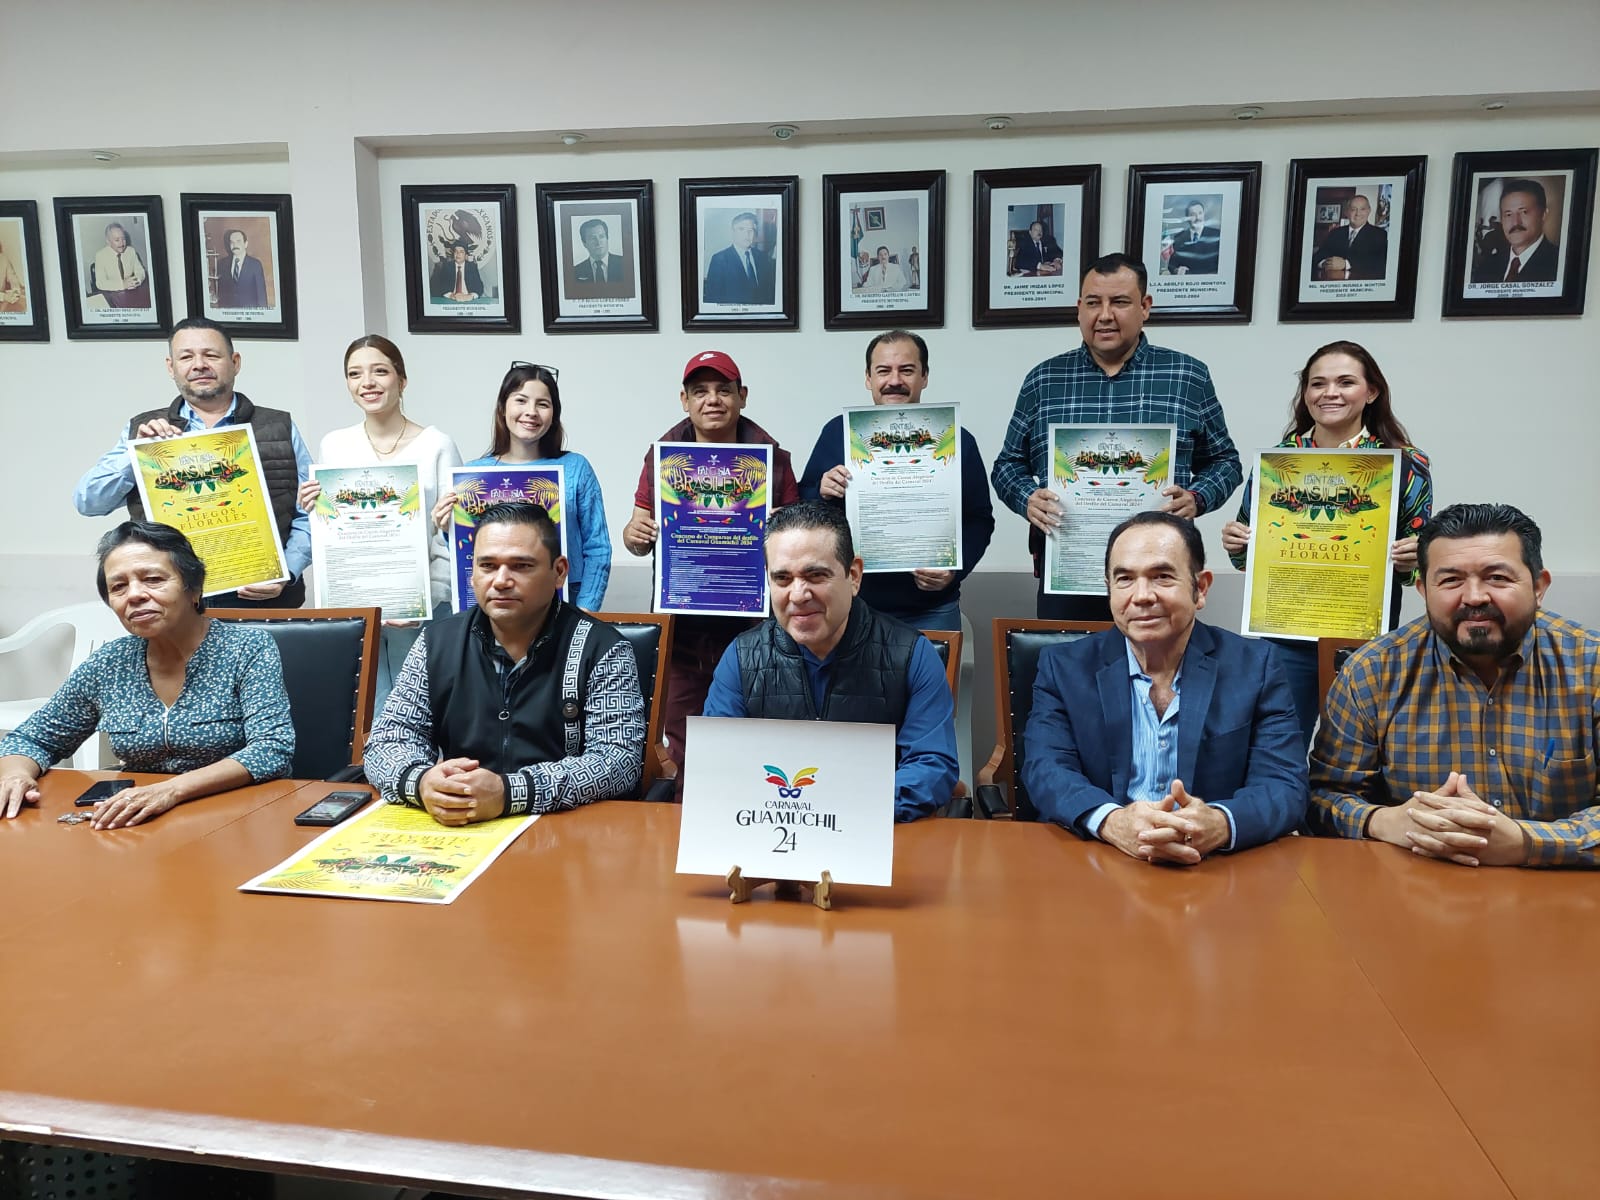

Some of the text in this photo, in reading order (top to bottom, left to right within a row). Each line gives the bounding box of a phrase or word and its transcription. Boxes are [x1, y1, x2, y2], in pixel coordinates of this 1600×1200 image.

[180, 512, 248, 530] FLORALES
[186, 507, 236, 522] JUEGOS
[1280, 549, 1360, 561] FLORALES
[1290, 543, 1349, 552] JUEGOS
[765, 800, 814, 811] CARNAVAL
[736, 809, 842, 832] GUAMÚCHIL
[772, 826, 797, 853] 24
